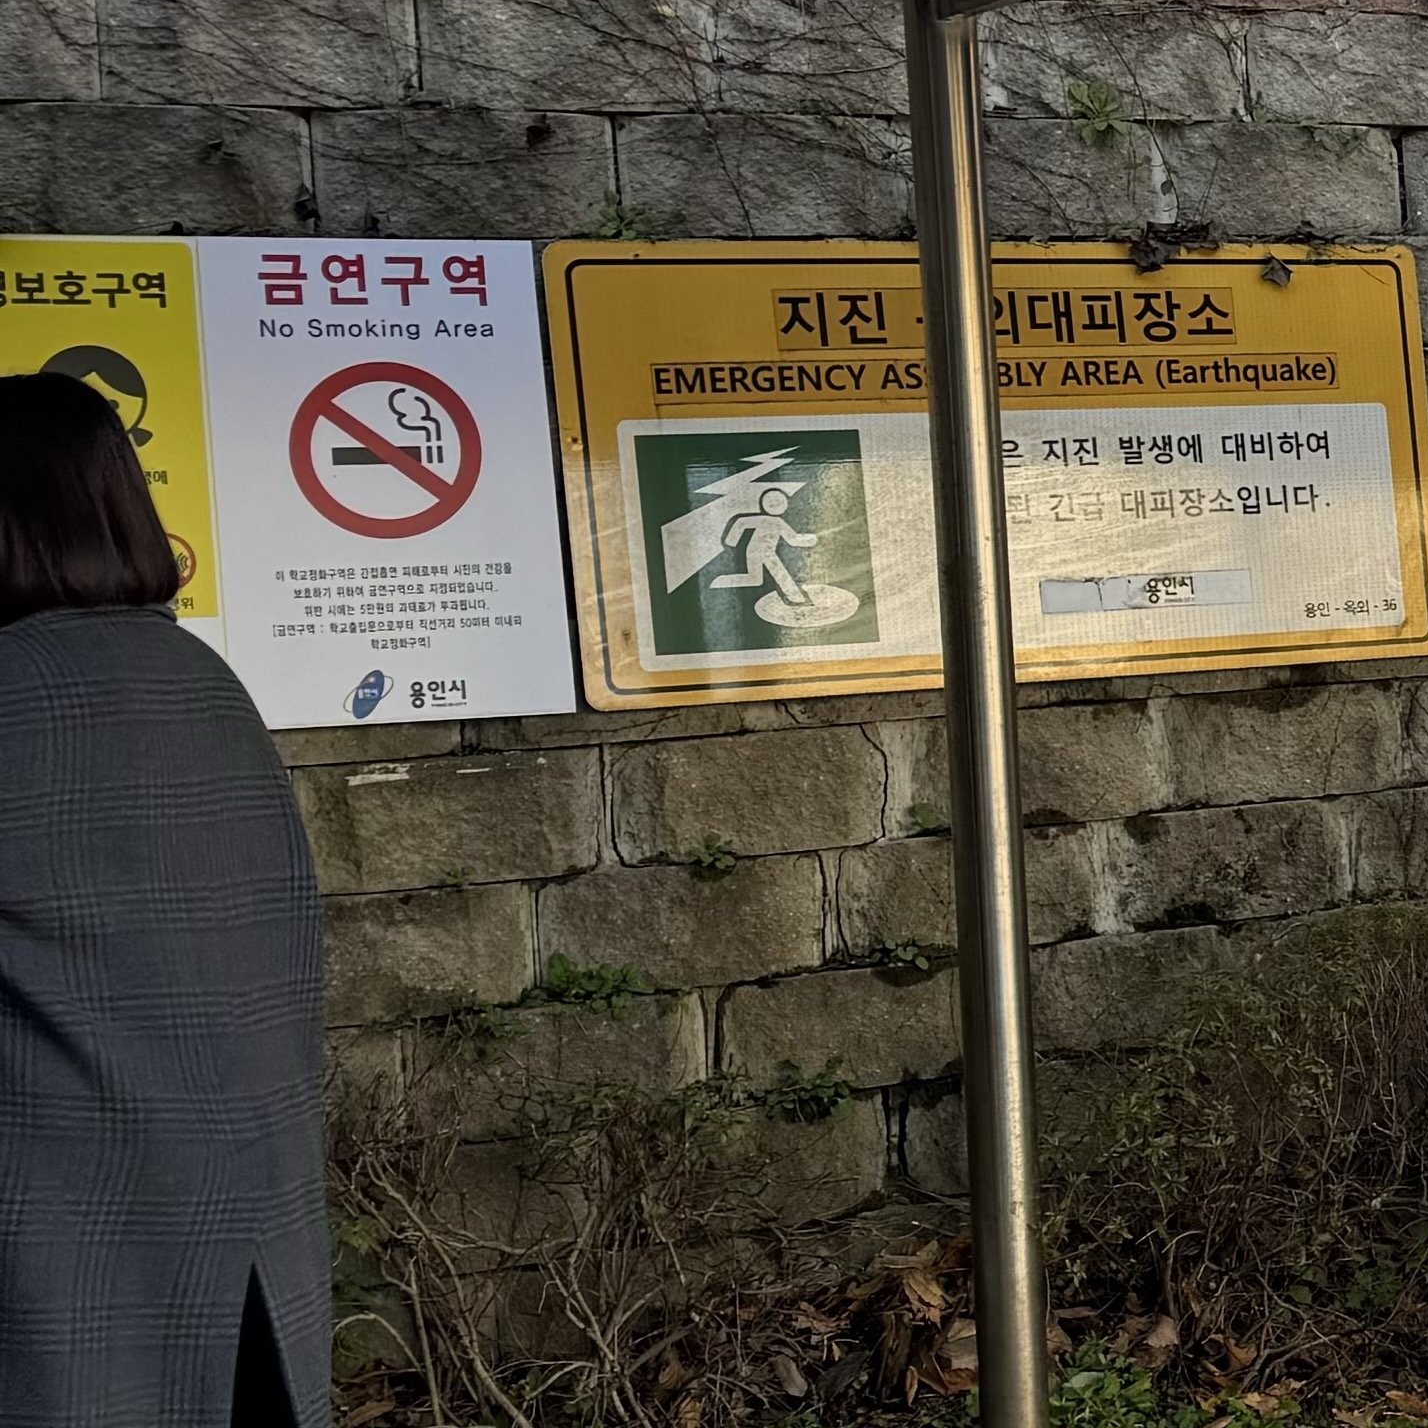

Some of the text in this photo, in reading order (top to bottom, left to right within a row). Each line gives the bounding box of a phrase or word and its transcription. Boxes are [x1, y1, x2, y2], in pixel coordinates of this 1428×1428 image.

[257, 253, 489, 307] 금연구역
[259, 319, 495, 340] No Smoking Area
[777, 290, 1235, 348] 지진 외대피장소
[654, 356, 1337, 395] EMERGENCY ASBLY AREA (Earthquake)
[1002, 429, 1332, 469] 은 지진 발생에 대비하여
[1048, 492, 1106, 523] 긴급
[1121, 483, 1332, 521] 대피장소입니다.
[275, 571, 285, 582] 이
[1144, 575, 1195, 605] 용인시
[1382, 598, 1398, 612] 36
[409, 679, 467, 709] 용인시
